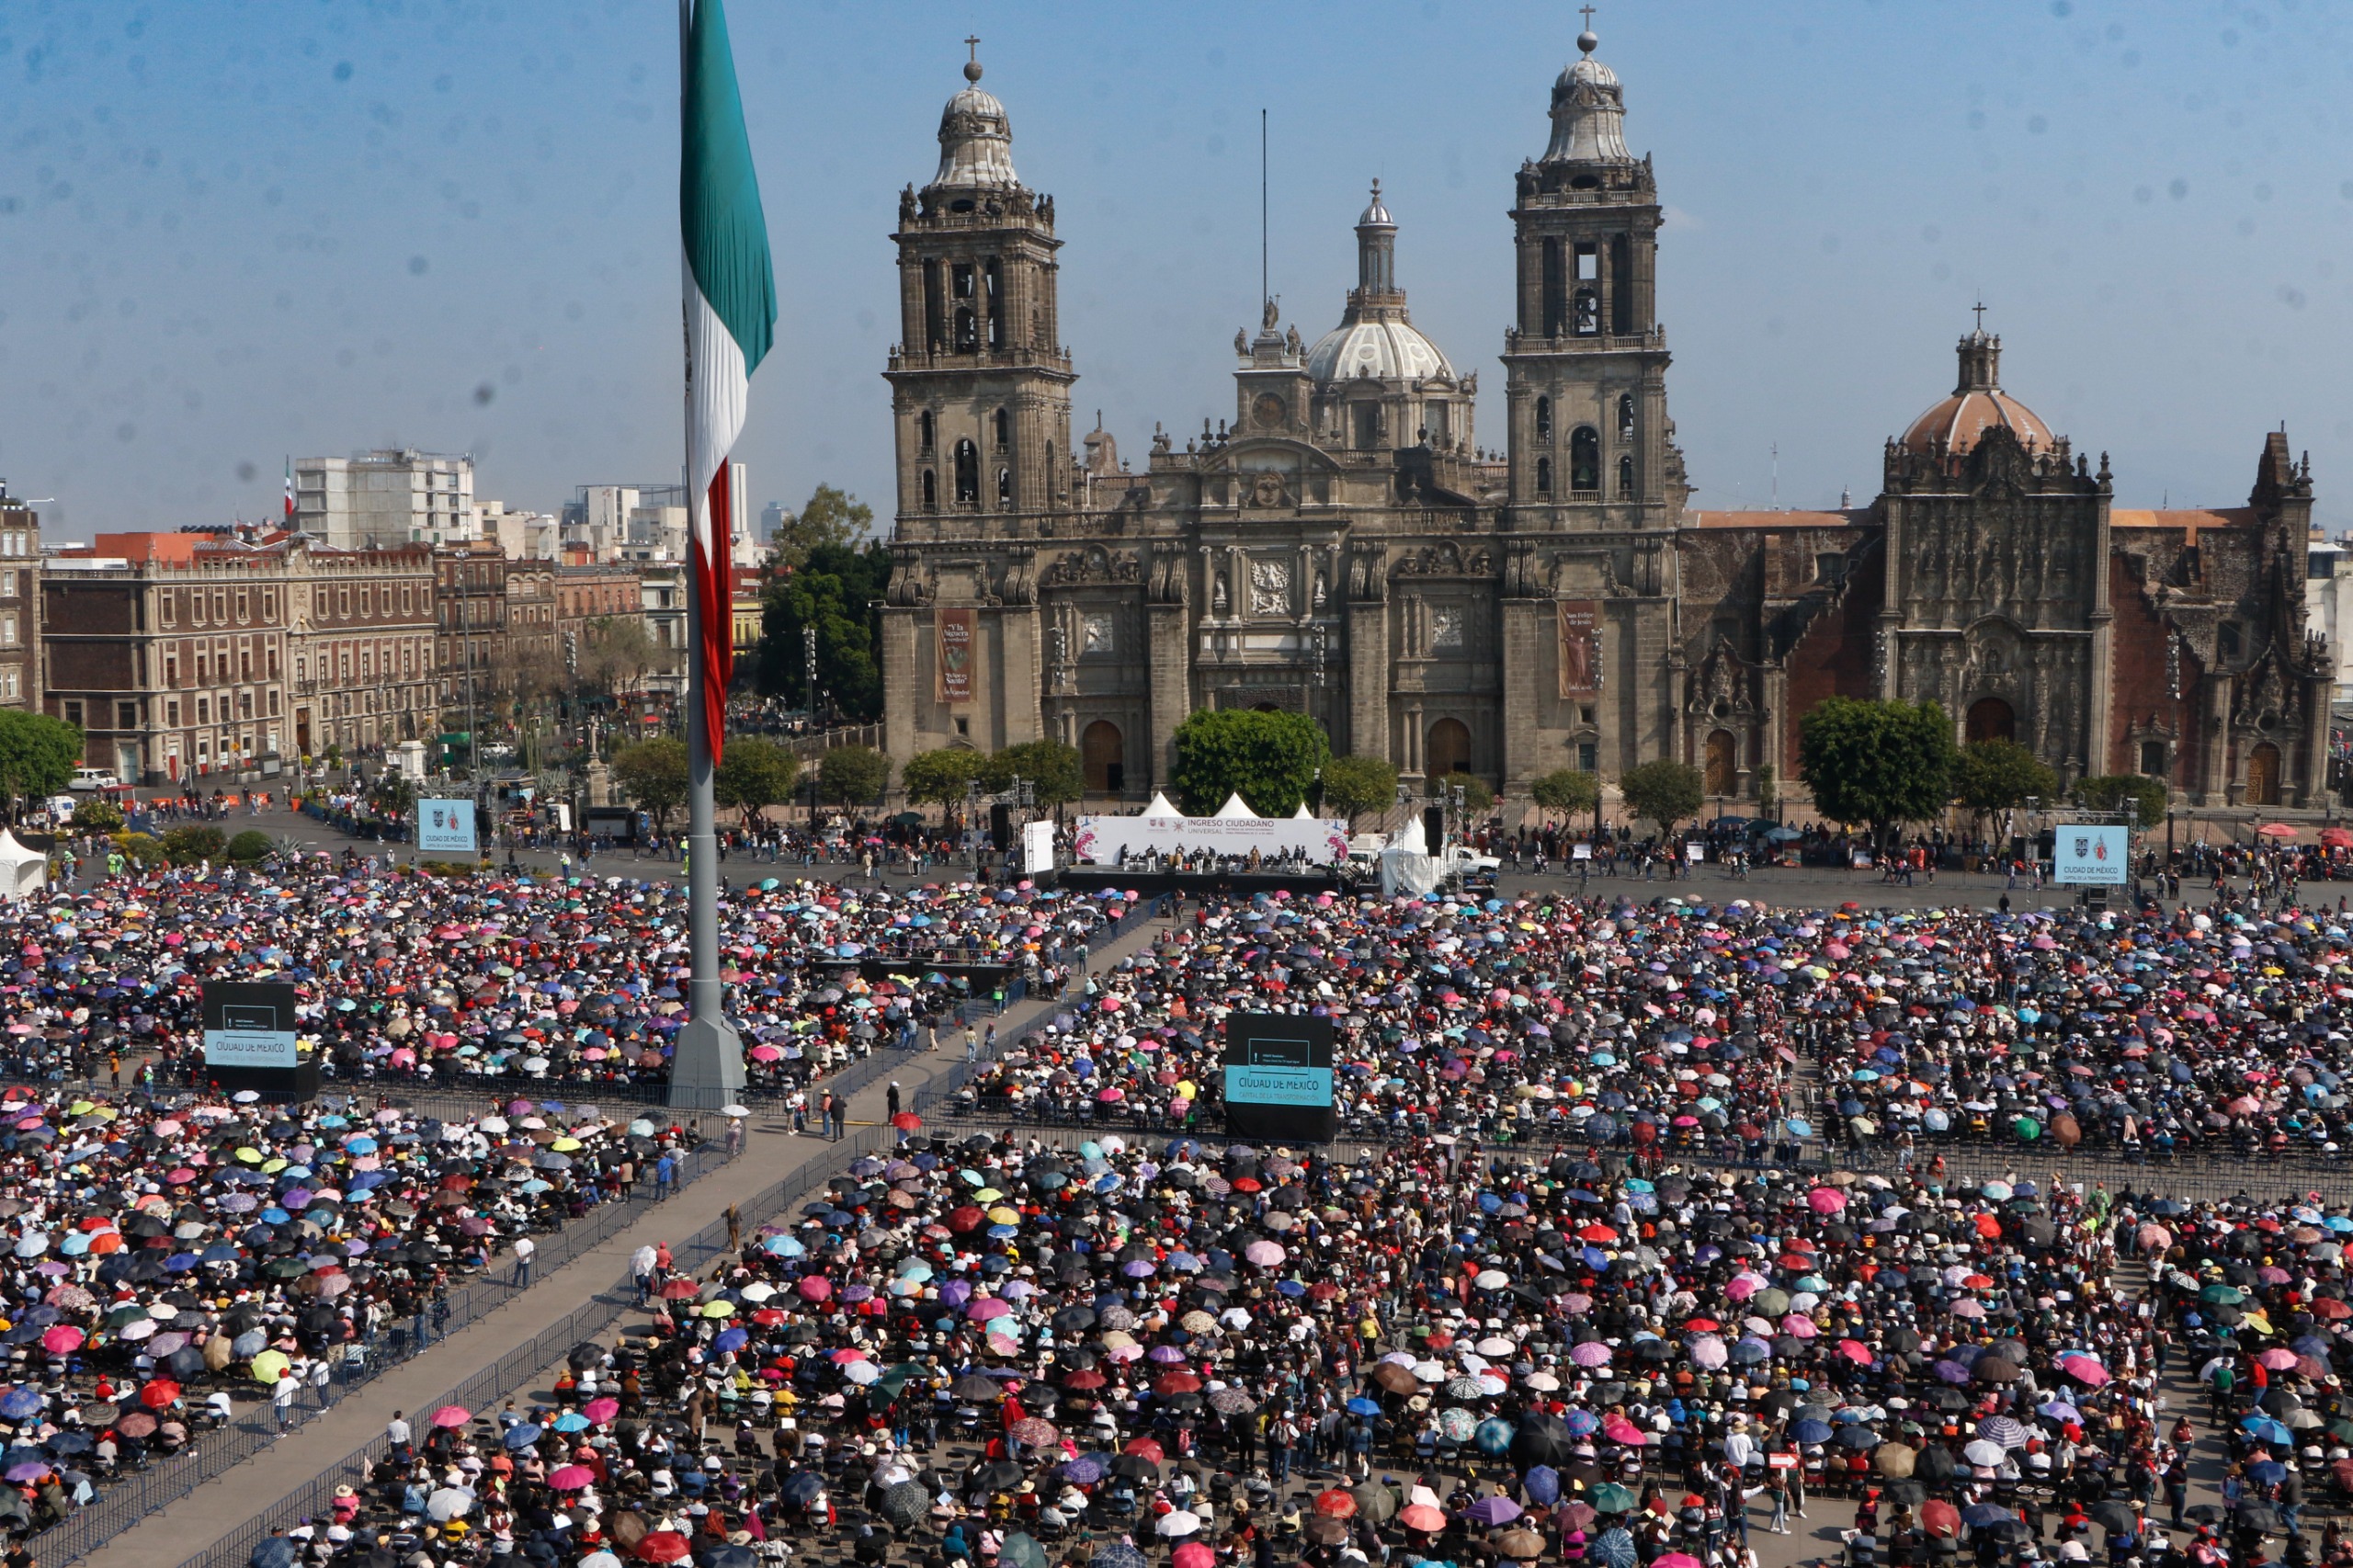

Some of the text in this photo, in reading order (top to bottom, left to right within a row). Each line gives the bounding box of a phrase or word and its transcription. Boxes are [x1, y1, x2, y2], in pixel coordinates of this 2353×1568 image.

[1188, 819, 1275, 828] INGRESO CIUDADANO
[450, 834, 468, 843] MÉXICO
[2096, 865, 2119, 874] MÉXICO
[216, 1041, 244, 1051] CIUDAD
[245, 1043, 256, 1052] DE
[1238, 1077, 1271, 1088] CIUDAD
[1273, 1080, 1284, 1089] DE
